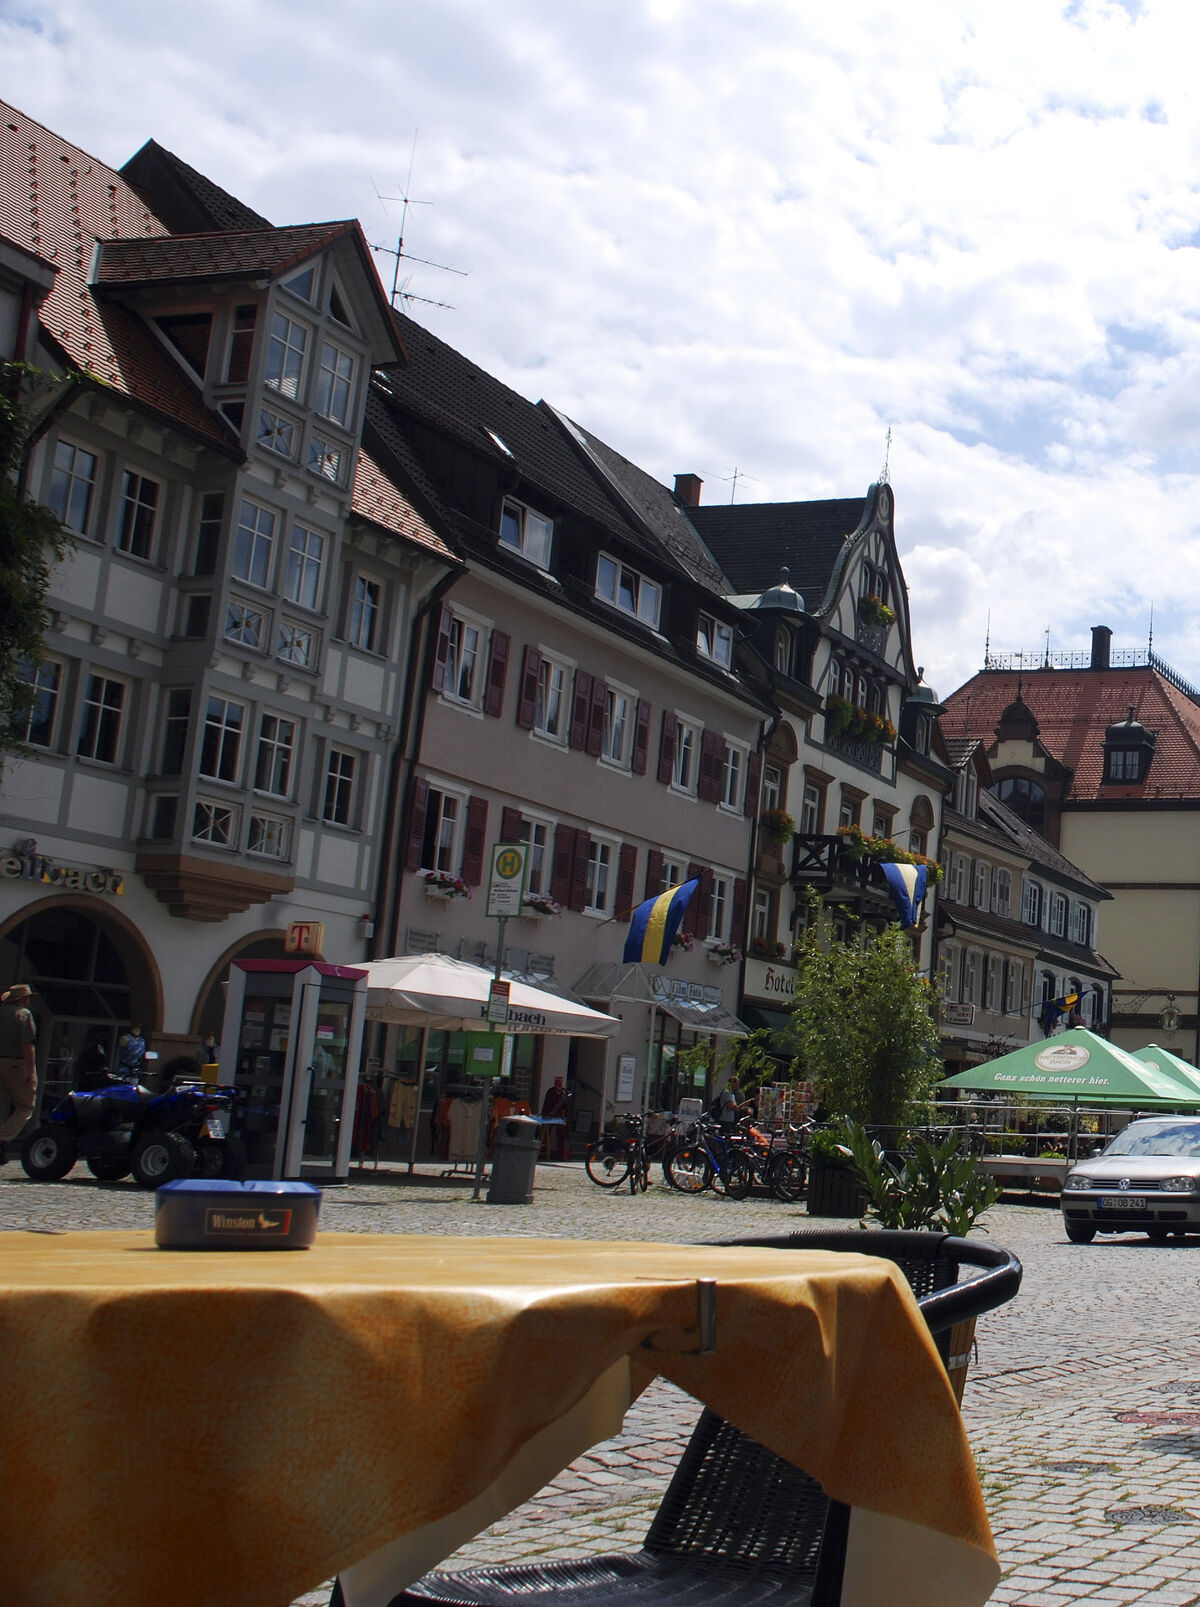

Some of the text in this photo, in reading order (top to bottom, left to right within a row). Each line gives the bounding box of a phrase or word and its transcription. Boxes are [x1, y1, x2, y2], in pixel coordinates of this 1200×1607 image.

[502, 856, 516, 872] H
[291, 925, 310, 950] T
[480, 1006, 546, 1025] Kbach
[994, 1072, 1017, 1081] Ganz
[1019, 1074, 1046, 1083] schön
[1089, 1076, 1110, 1085] hier.
[1130, 1199, 1145, 1208] 241
[212, 1214, 256, 1230] Winston
